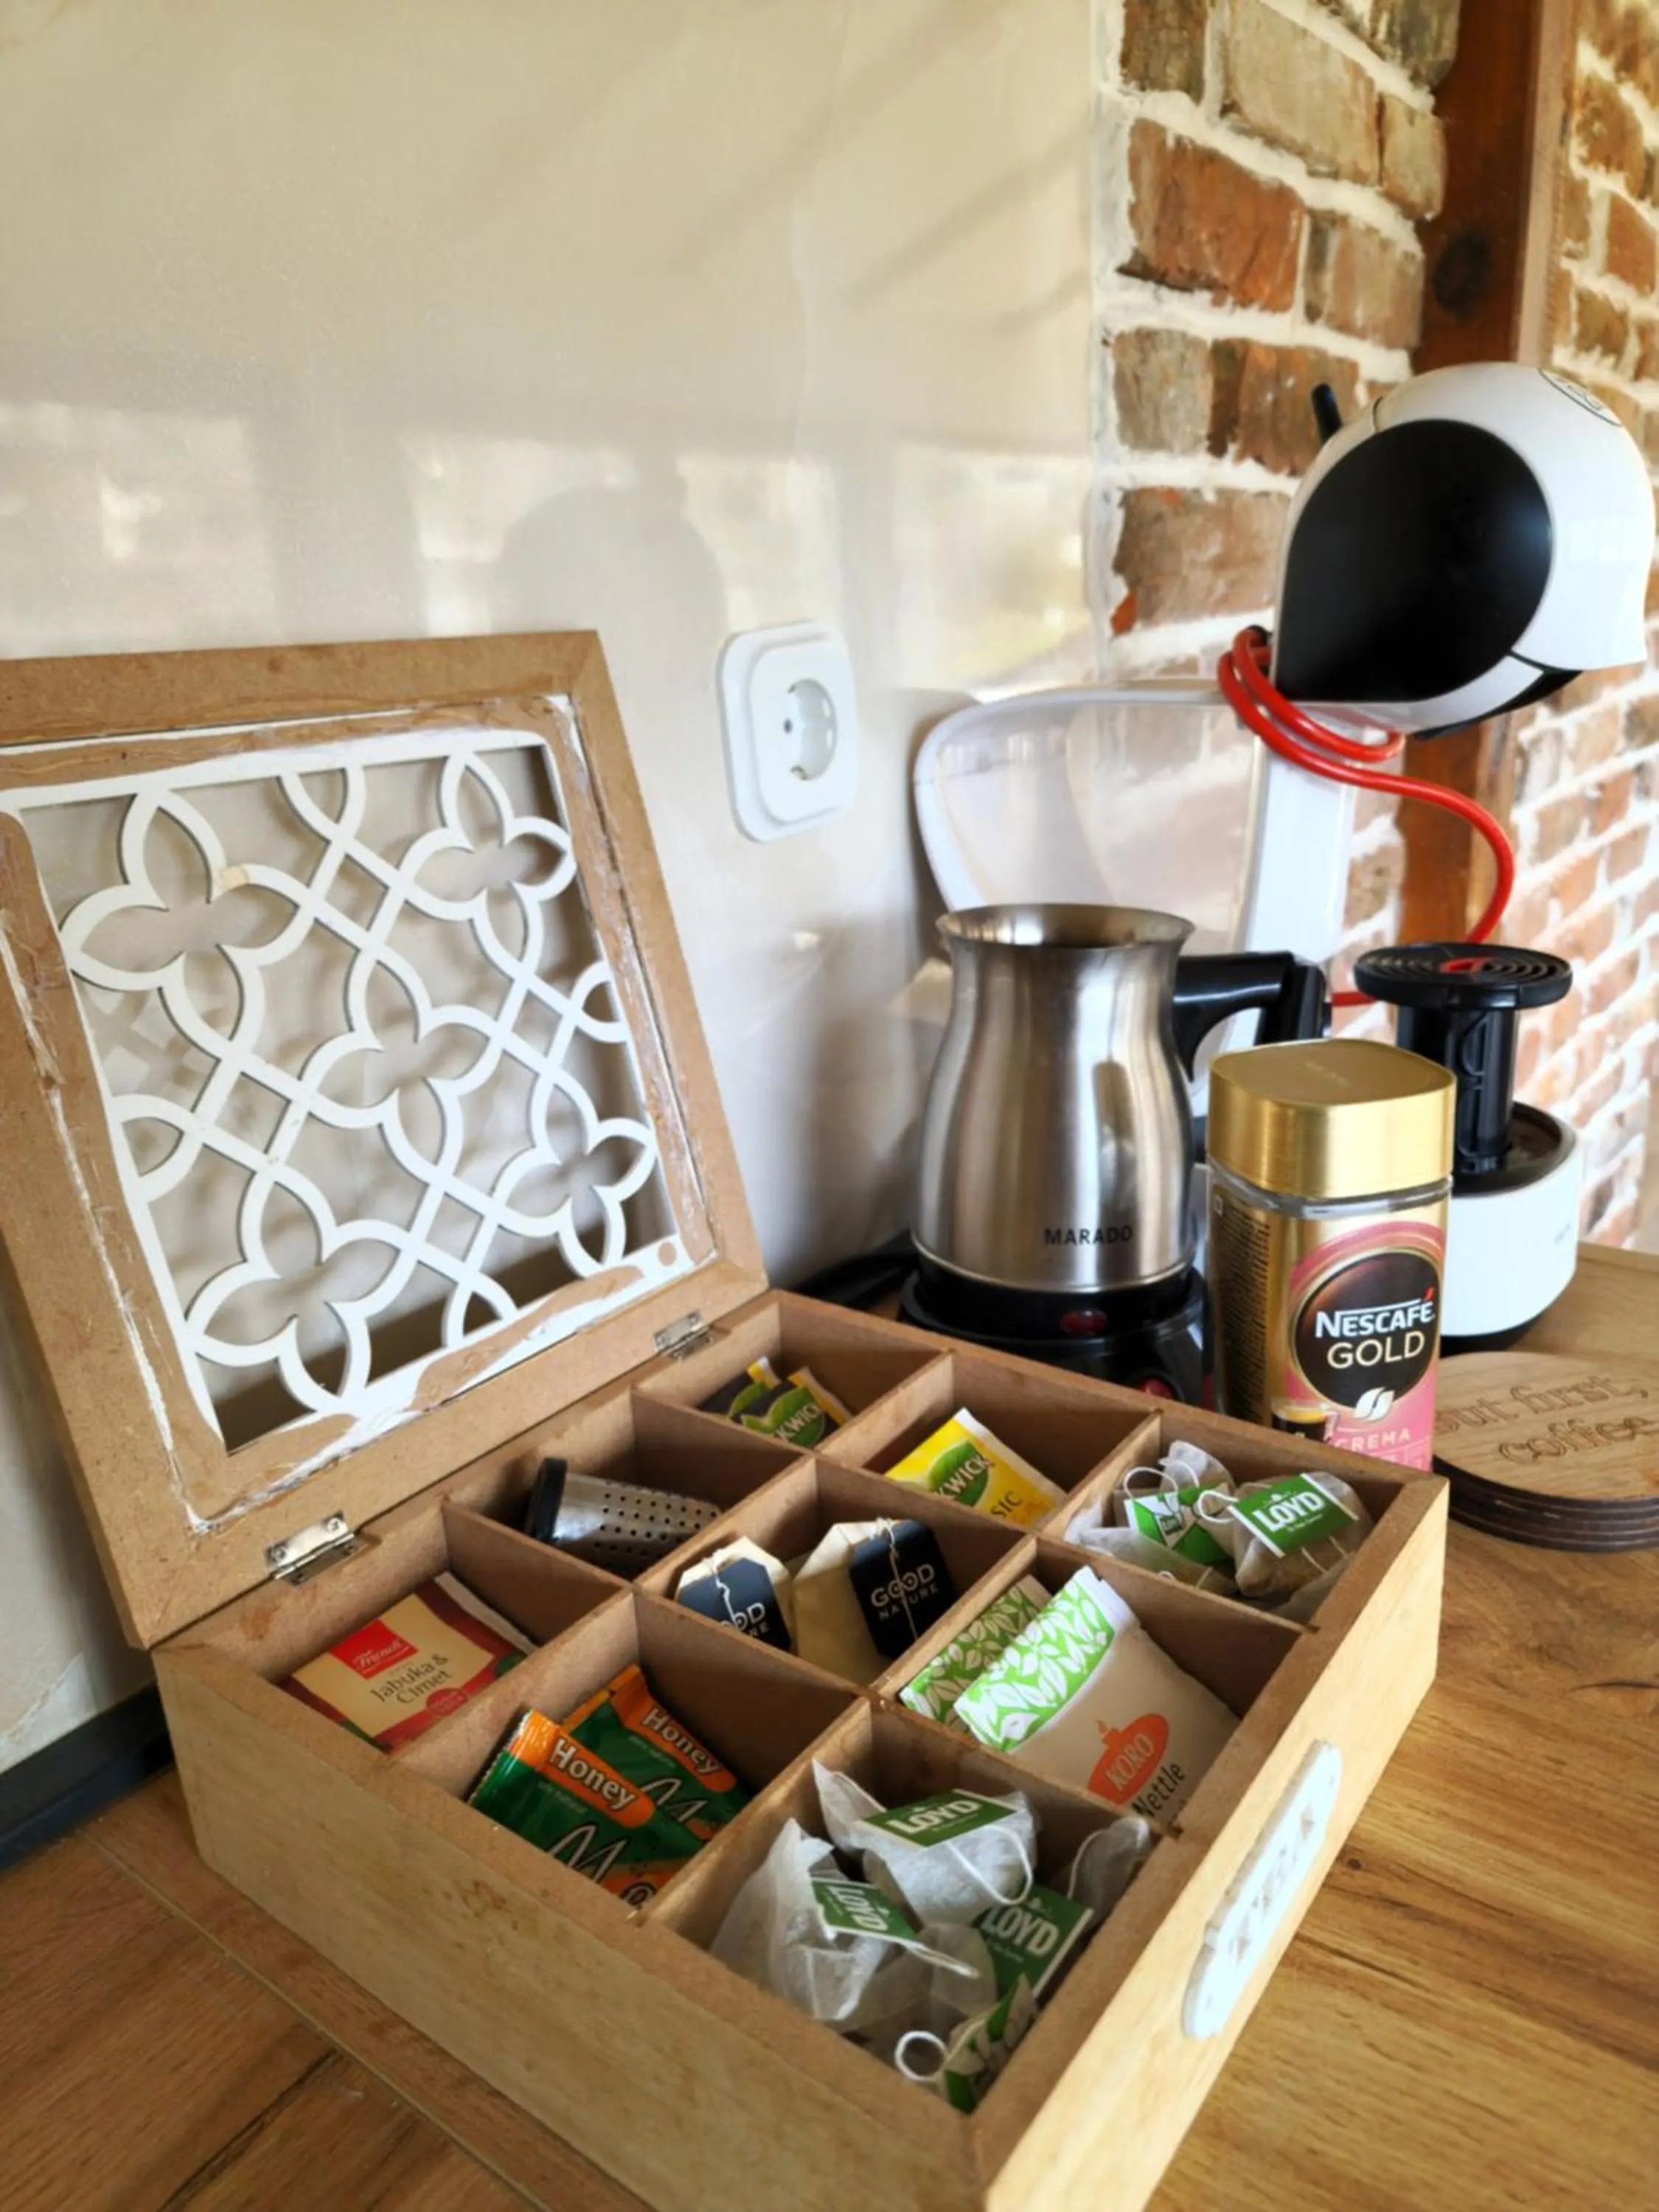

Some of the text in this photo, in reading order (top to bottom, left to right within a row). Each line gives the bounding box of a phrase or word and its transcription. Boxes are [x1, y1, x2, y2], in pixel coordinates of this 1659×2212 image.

[1044, 1224, 1133, 1246] MARADO
[1315, 1287, 1434, 1339] NESCAFÉ
[1326, 1330, 1425, 1369] GOLD
[1253, 1490, 1326, 1532] LOYD
[870, 1563, 935, 1608] GOOD
[879, 1583, 939, 1620] NAURE
[370, 1660, 438, 1703] Jabuka
[431, 1652, 449, 1666] &
[642, 1708, 720, 1773] Honey
[549, 1737, 636, 1811] Honey
[1130, 1763, 1186, 1818] Nettle
[886, 1799, 981, 1834] LOYD
[827, 1885, 889, 1931] LOYD
[979, 1905, 1060, 1958] LOYD
